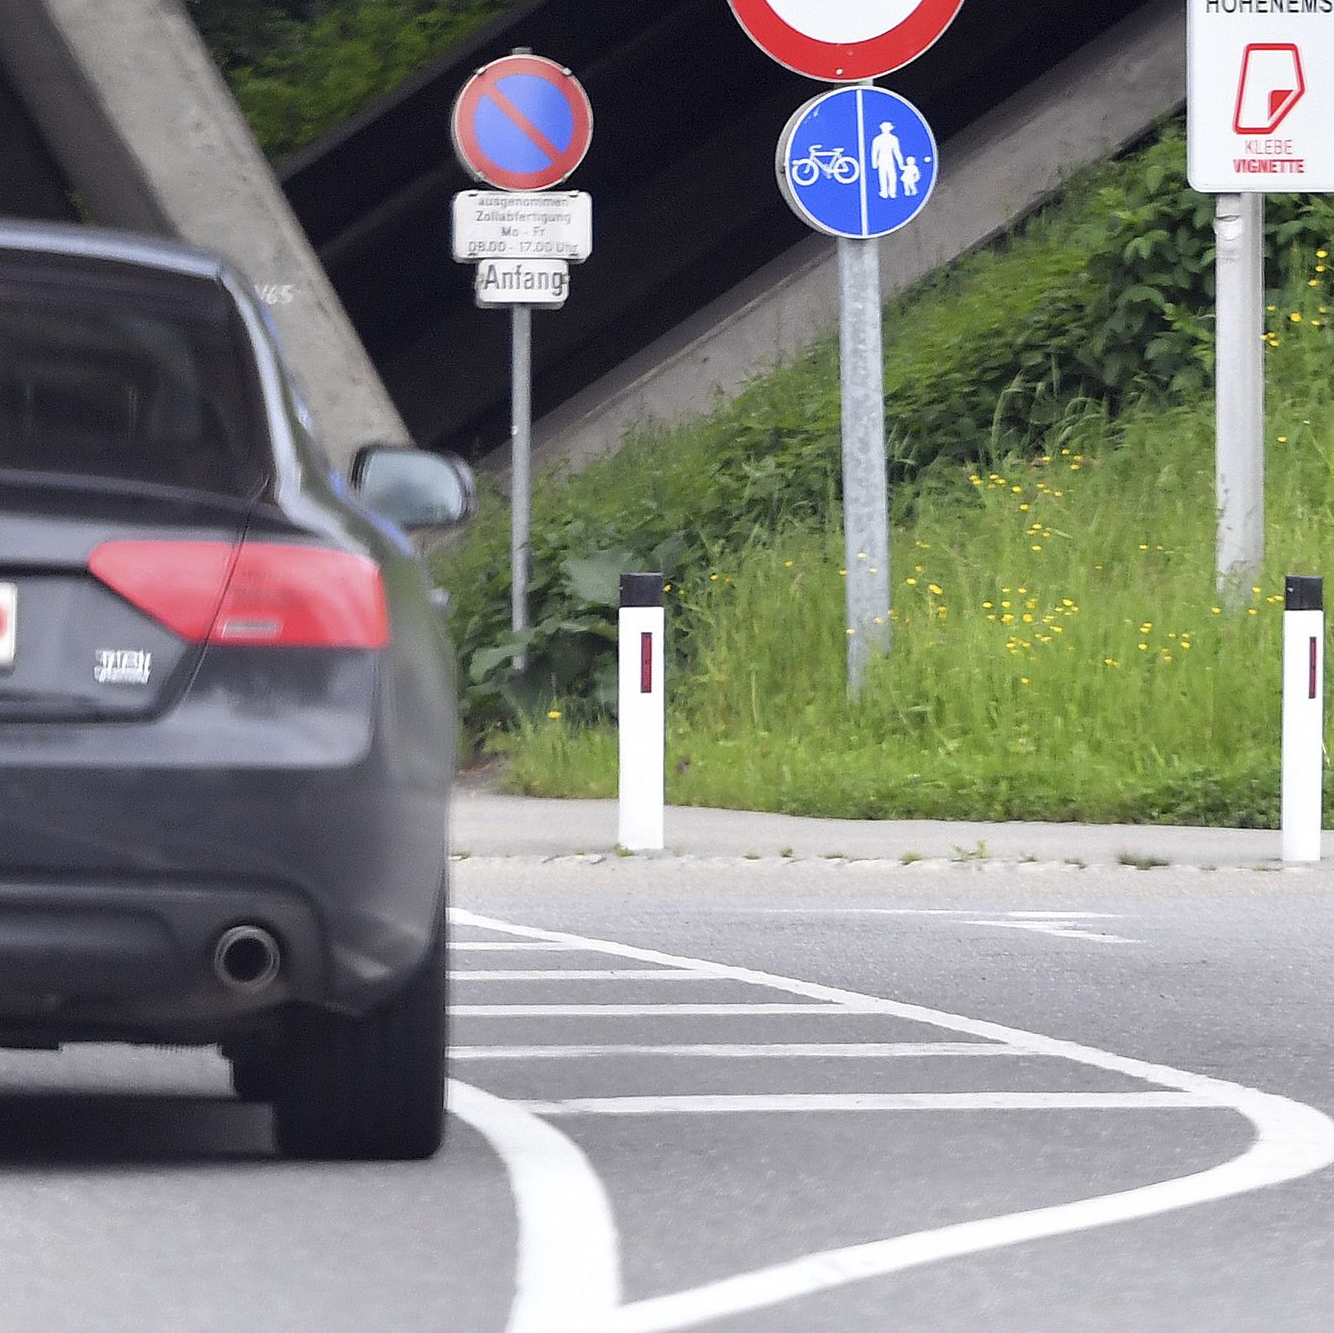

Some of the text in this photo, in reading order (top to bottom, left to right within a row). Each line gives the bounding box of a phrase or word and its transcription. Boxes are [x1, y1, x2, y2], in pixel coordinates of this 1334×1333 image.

[1245, 139, 1293, 155] KLEBE
[1233, 159, 1304, 174] VIGNETTE
[501, 226, 519, 237] Mo
[484, 264, 563, 297] Anfang
